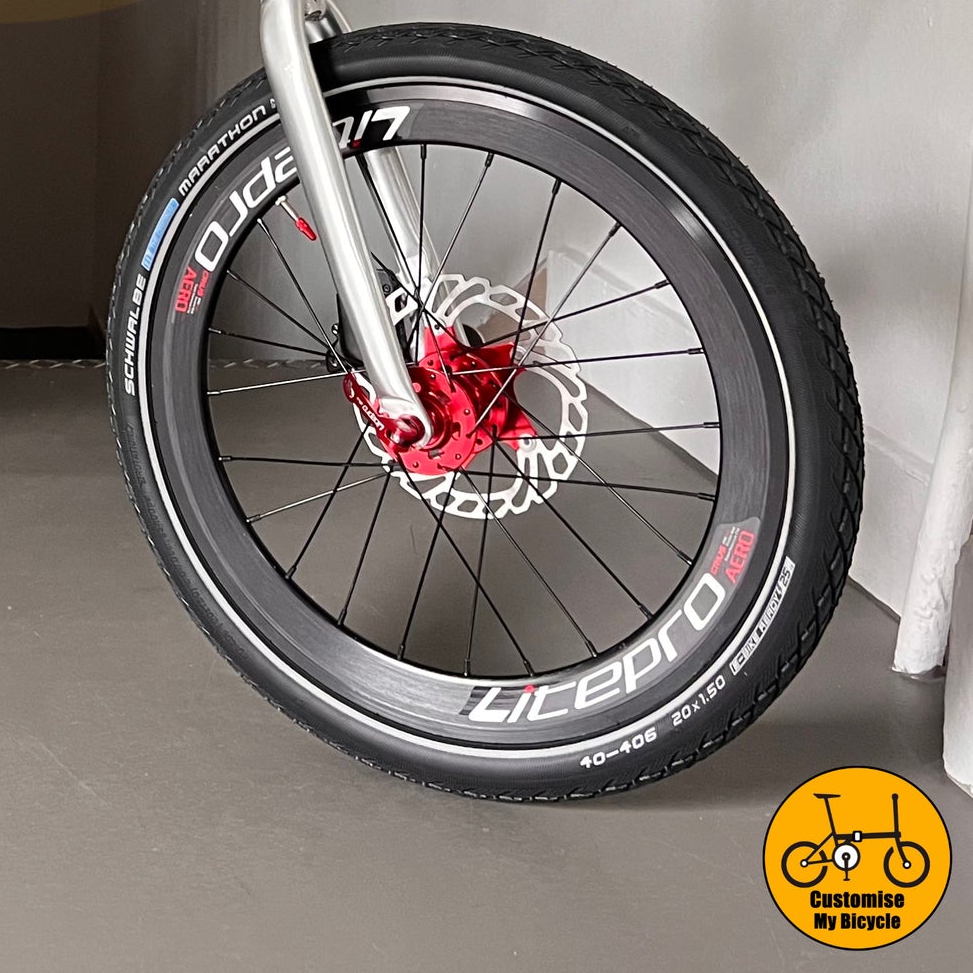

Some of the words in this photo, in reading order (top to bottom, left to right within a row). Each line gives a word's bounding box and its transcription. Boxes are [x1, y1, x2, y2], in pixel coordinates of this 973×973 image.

[123, 273, 147, 397] SCHWALBE
[178, 105, 267, 197] MARATHON
[175, 265, 197, 313] AERO
[725, 530, 756, 585] AERO
[468, 572, 726, 723] Litepro
[579, 726, 658, 769] 40-406
[671, 676, 726, 727] 20x1.50
